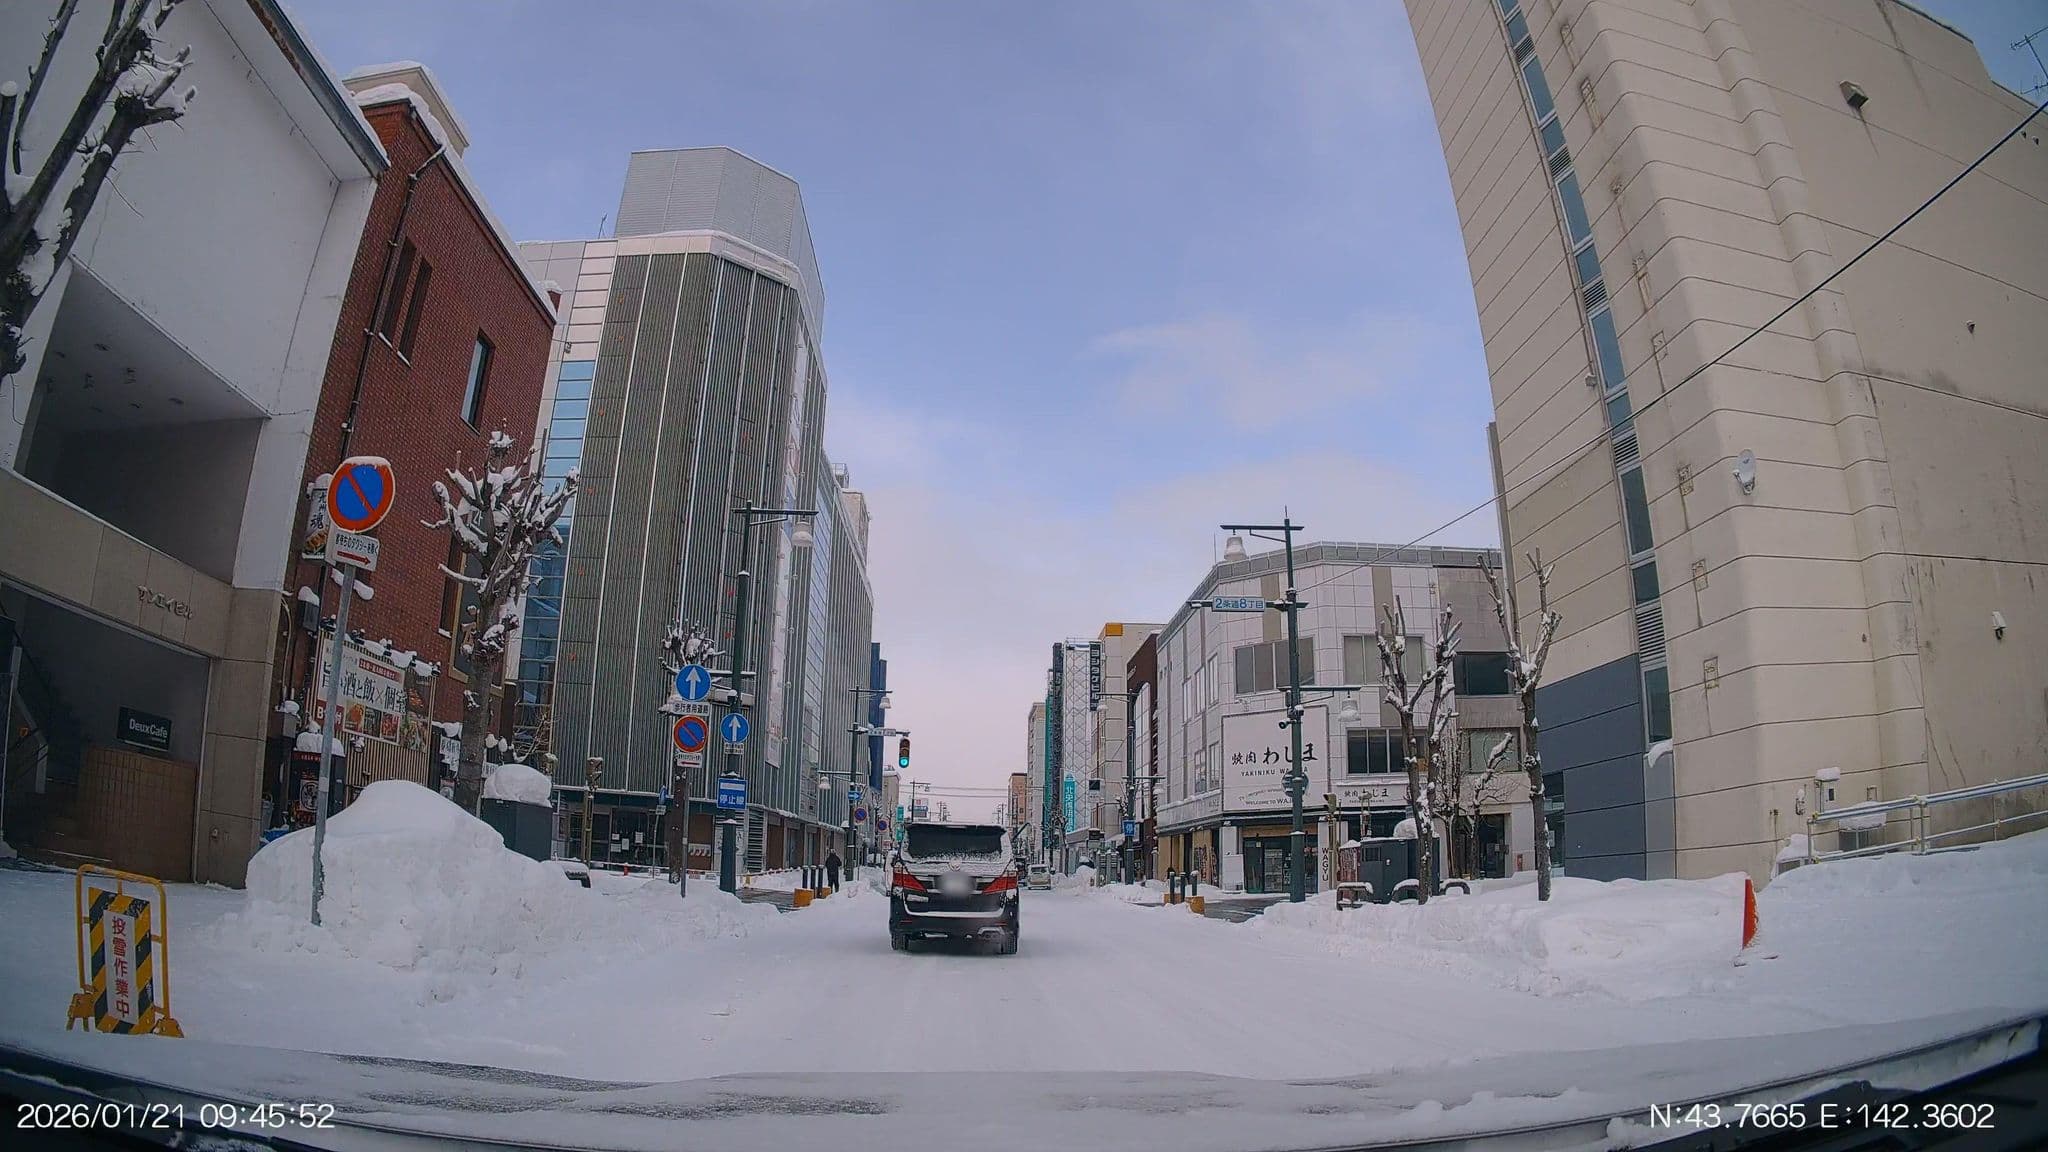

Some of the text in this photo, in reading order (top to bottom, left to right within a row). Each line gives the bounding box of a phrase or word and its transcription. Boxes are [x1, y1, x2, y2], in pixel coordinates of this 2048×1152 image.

[1215, 597, 1264, 609] 2条通8丁目
[1231, 750, 1257, 766] 焼肉
[1241, 769, 1276, 777] YAKINIKU
[719, 794, 745, 806] 停止線
[111, 915, 130, 1018] 投雪作業中
